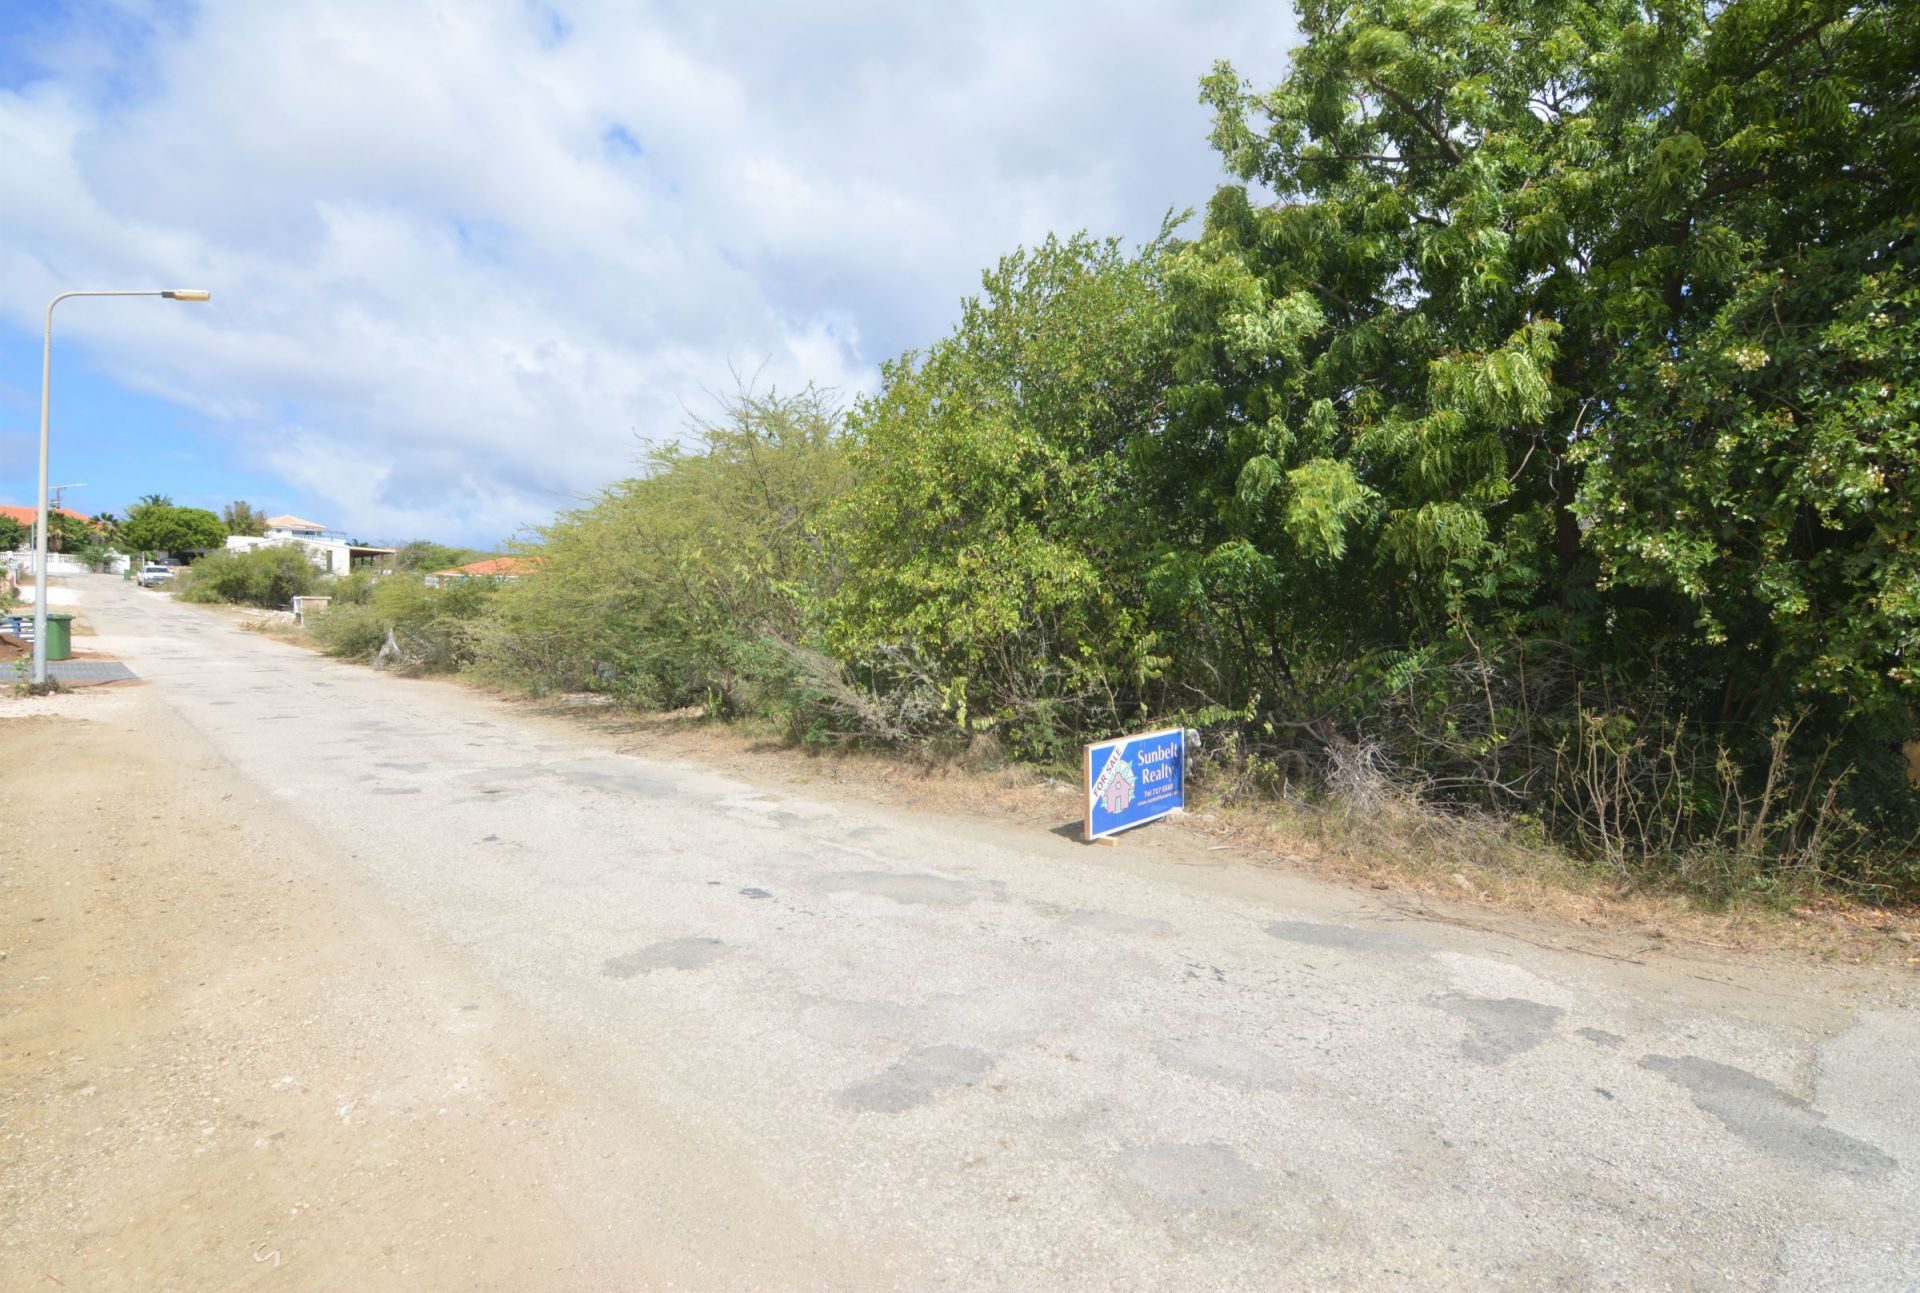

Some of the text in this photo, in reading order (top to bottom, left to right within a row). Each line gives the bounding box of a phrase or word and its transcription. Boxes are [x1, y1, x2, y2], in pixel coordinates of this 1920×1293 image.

[1137, 742, 1178, 766] Sunbelt
[1093, 748, 1121, 797] FOR SALE
[1142, 763, 1174, 784] Realty
